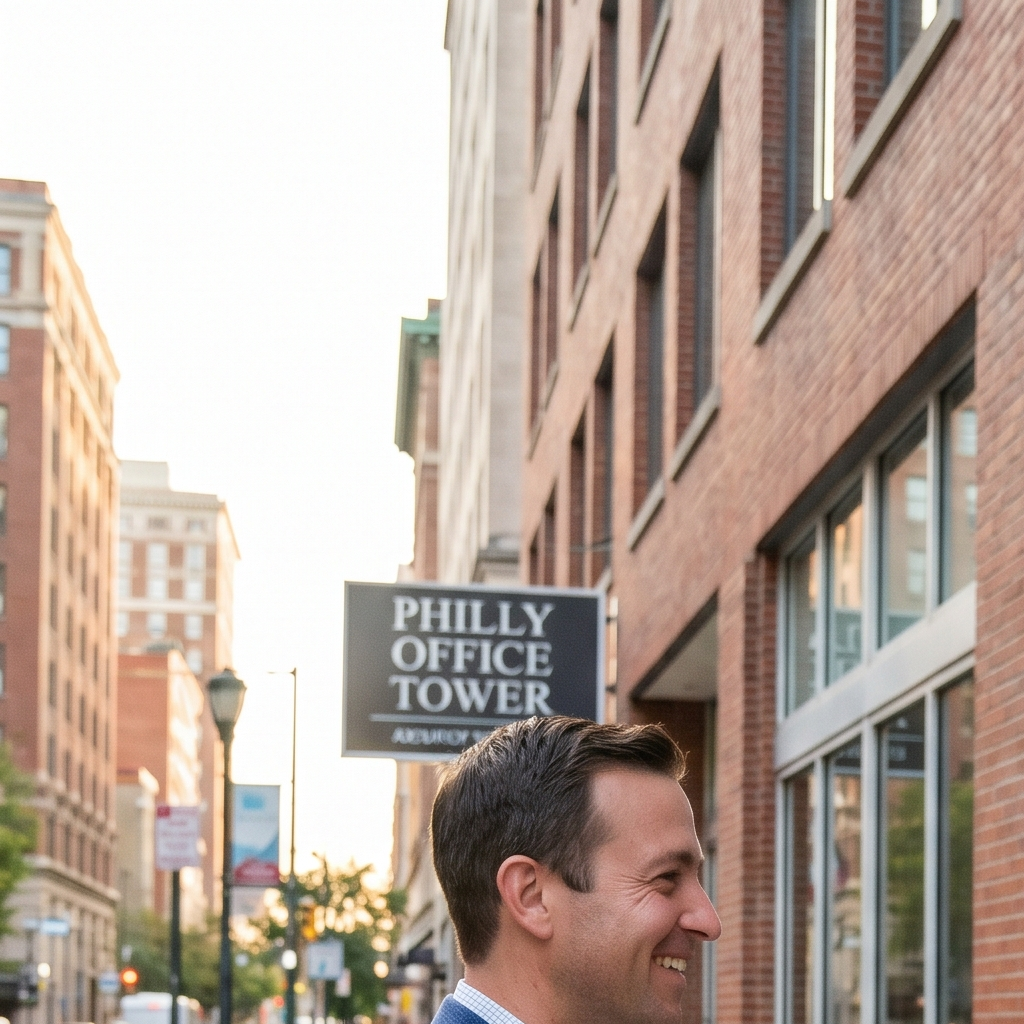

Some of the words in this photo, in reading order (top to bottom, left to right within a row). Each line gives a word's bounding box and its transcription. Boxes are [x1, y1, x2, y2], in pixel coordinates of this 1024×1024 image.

[391, 595, 556, 637] PHILLY
[390, 635, 554, 677] OFFICE
[388, 675, 554, 715] TOWER
